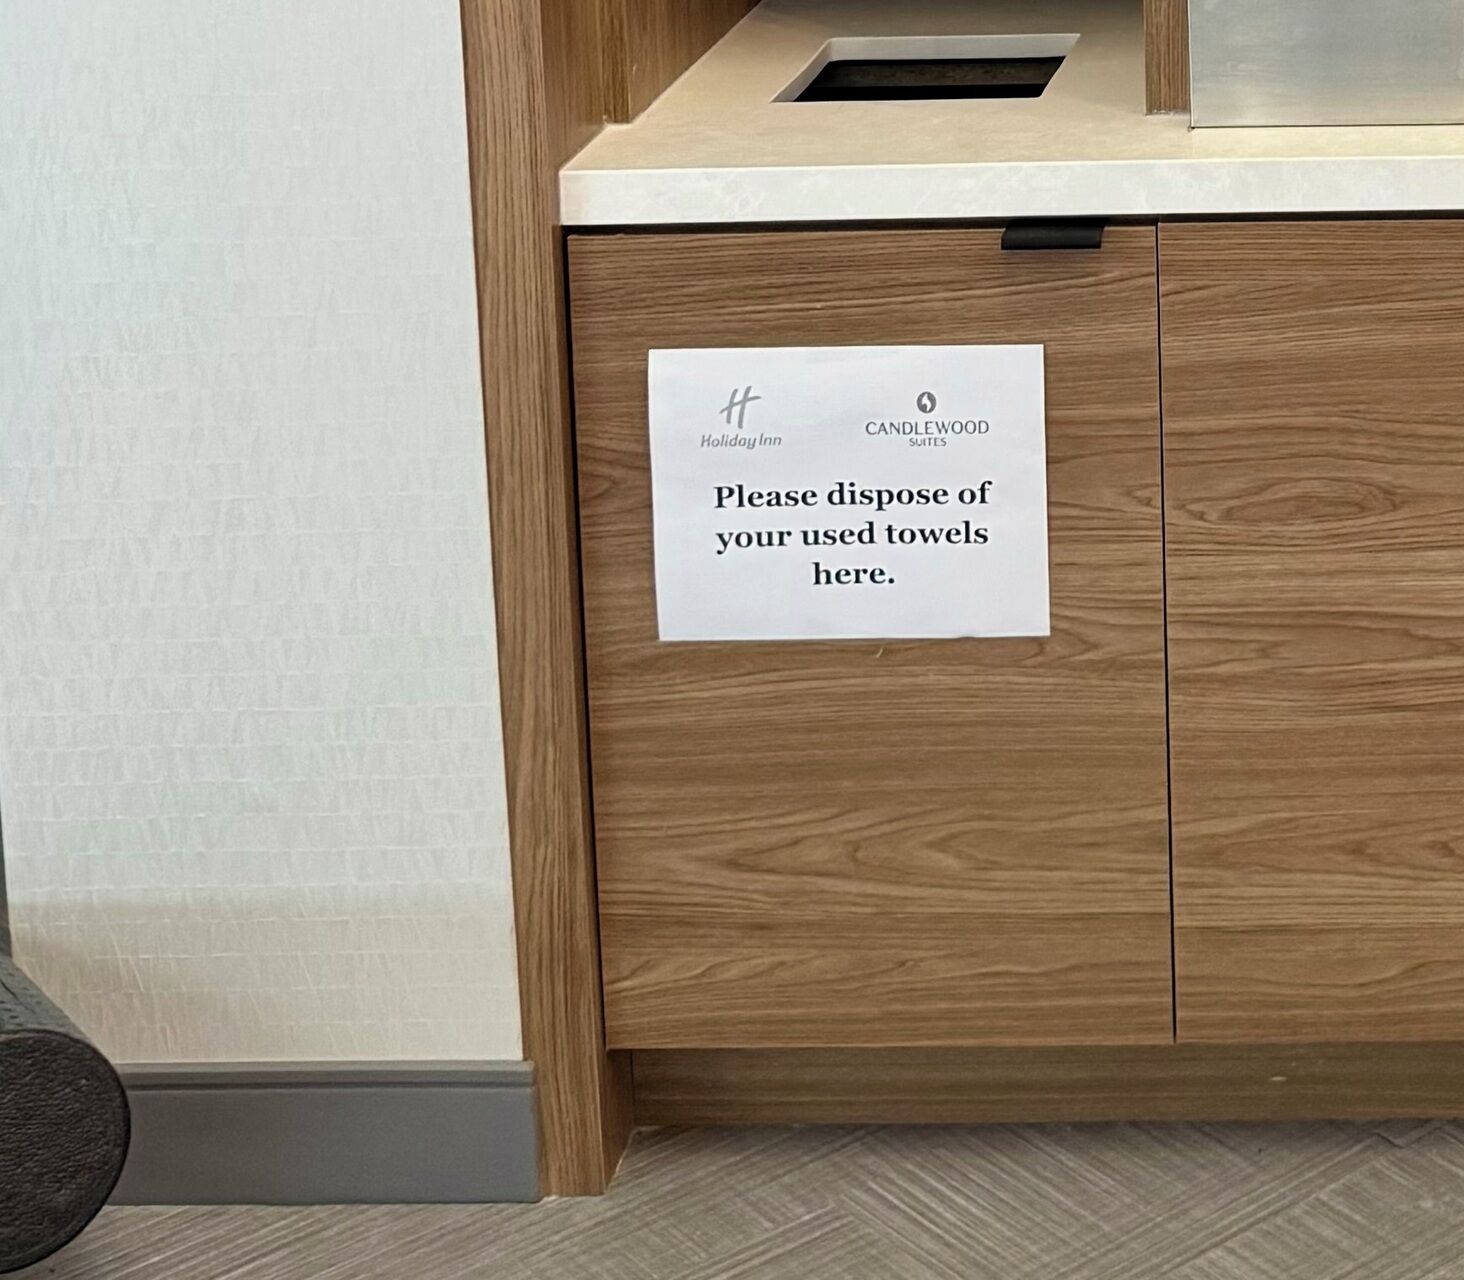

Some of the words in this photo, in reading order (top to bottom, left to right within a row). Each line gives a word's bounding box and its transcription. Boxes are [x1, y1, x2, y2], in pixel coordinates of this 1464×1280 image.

[865, 419, 990, 436] CANDLEWOOD
[700, 433, 757, 450] Holiday
[758, 433, 782, 446] Inn
[908, 436, 948, 448] SUITES
[713, 484, 819, 509] Please
[826, 481, 950, 512] dispose
[957, 480, 993, 505] of
[715, 529, 793, 556] your
[800, 520, 877, 546] used
[884, 520, 990, 545] towels
[812, 561, 895, 586] here.
